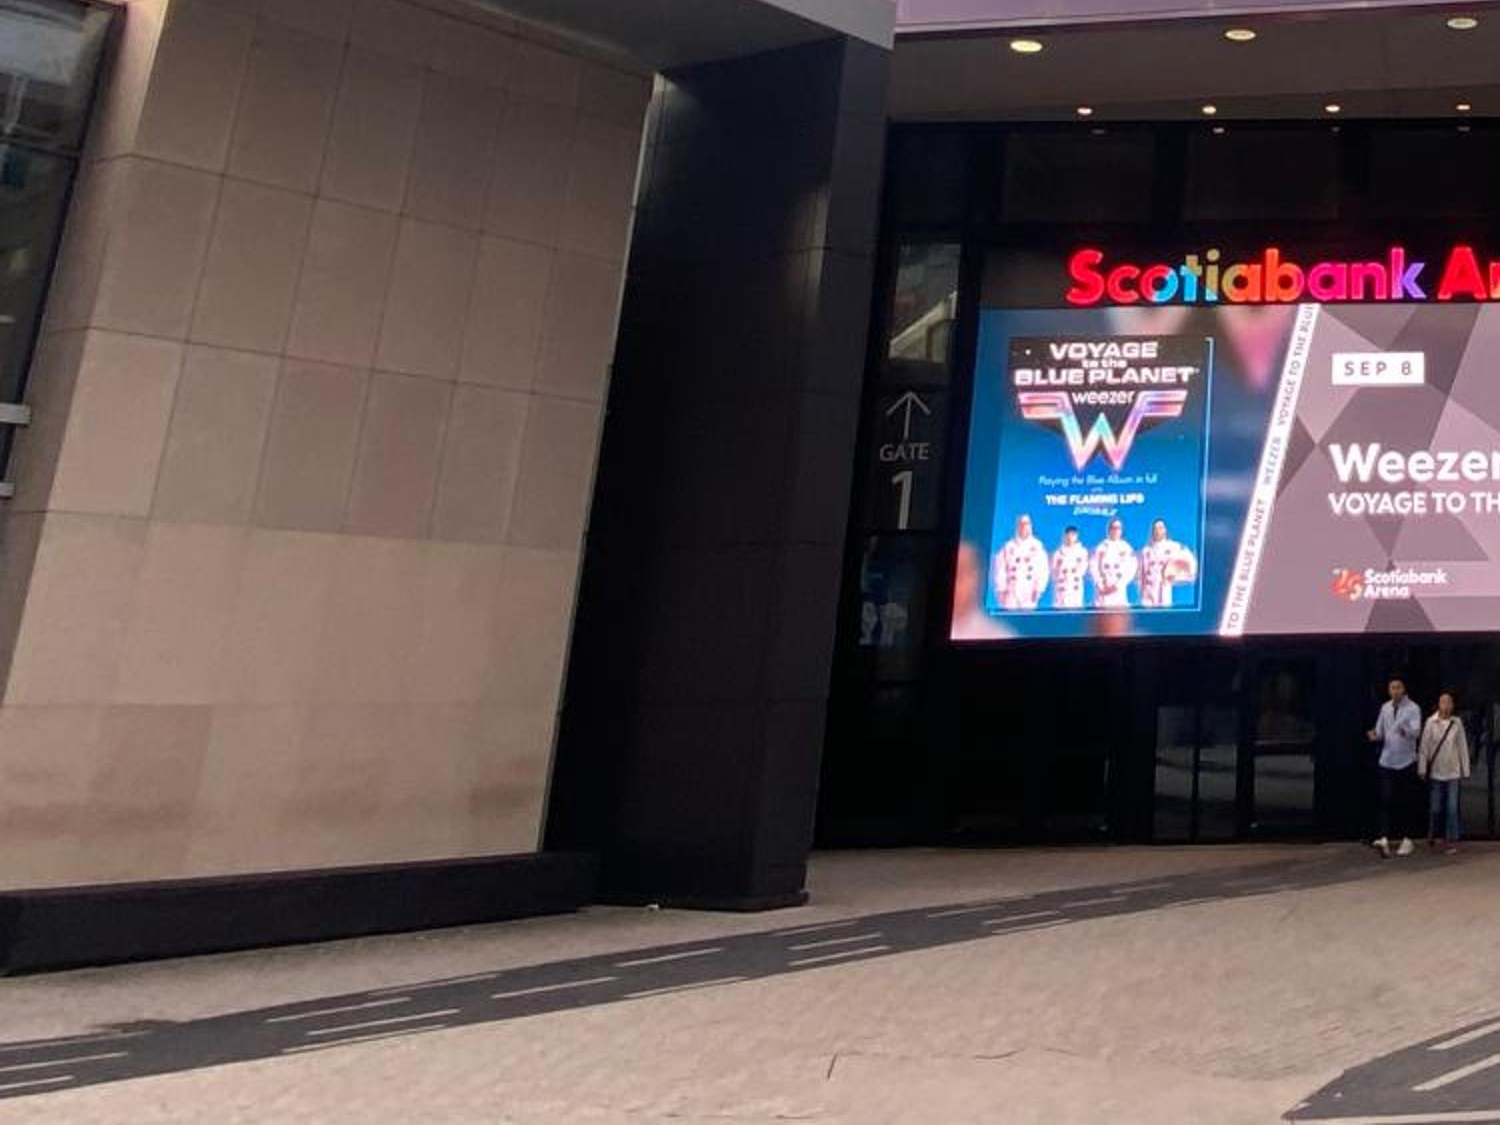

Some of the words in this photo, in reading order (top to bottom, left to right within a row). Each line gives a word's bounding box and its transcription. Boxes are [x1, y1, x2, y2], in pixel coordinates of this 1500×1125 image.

[1065, 247, 1428, 303] Scotiabank
[1049, 341, 1159, 360] VOYAGE
[1081, 359, 1099, 369] to
[1102, 358, 1128, 369] the
[1343, 361, 1387, 376] SEP
[1401, 361, 1413, 376] 8
[1014, 368, 1085, 386] BLUE
[1089, 366, 1195, 384] PLANET
[1071, 390, 1135, 405] weezer
[879, 442, 931, 461] GATE
[891, 469, 913, 531] 1
[1045, 494, 1068, 506] THE
[1328, 492, 1427, 515] VOYAGE
[1431, 491, 1467, 514] TO
[1247, 499, 1266, 547] PLANET
[1364, 568, 1447, 584] Scotiabank
[1232, 585, 1247, 608] THE
[1364, 584, 1409, 599] Arena
[1228, 612, 1240, 630] TO
